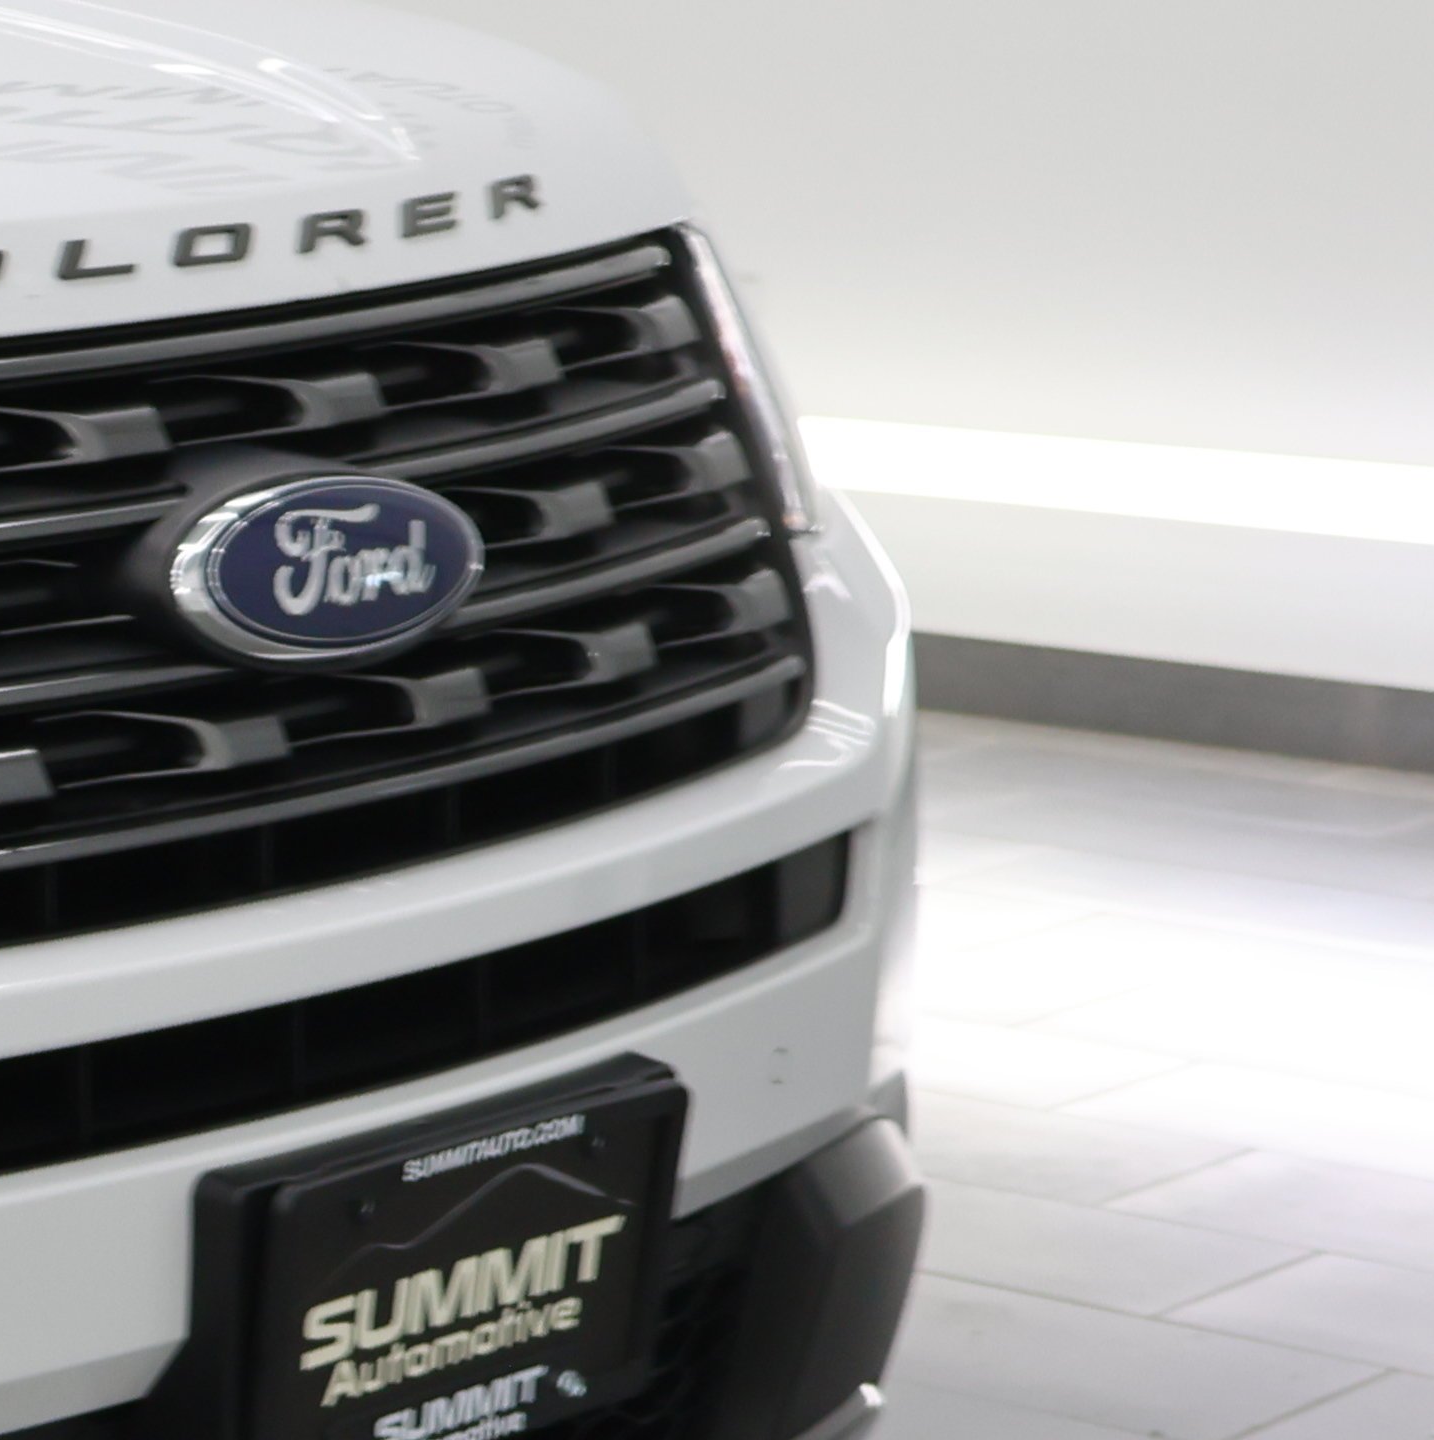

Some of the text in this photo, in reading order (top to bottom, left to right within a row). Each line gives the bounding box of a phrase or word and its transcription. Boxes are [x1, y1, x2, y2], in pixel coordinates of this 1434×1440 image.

[272, 502, 437, 616] Ford
[401, 1113, 586, 1182] SUMMITAUTO.COM
[299, 1213, 628, 1371] SUMMIT
[319, 1294, 583, 1408] Automotive
